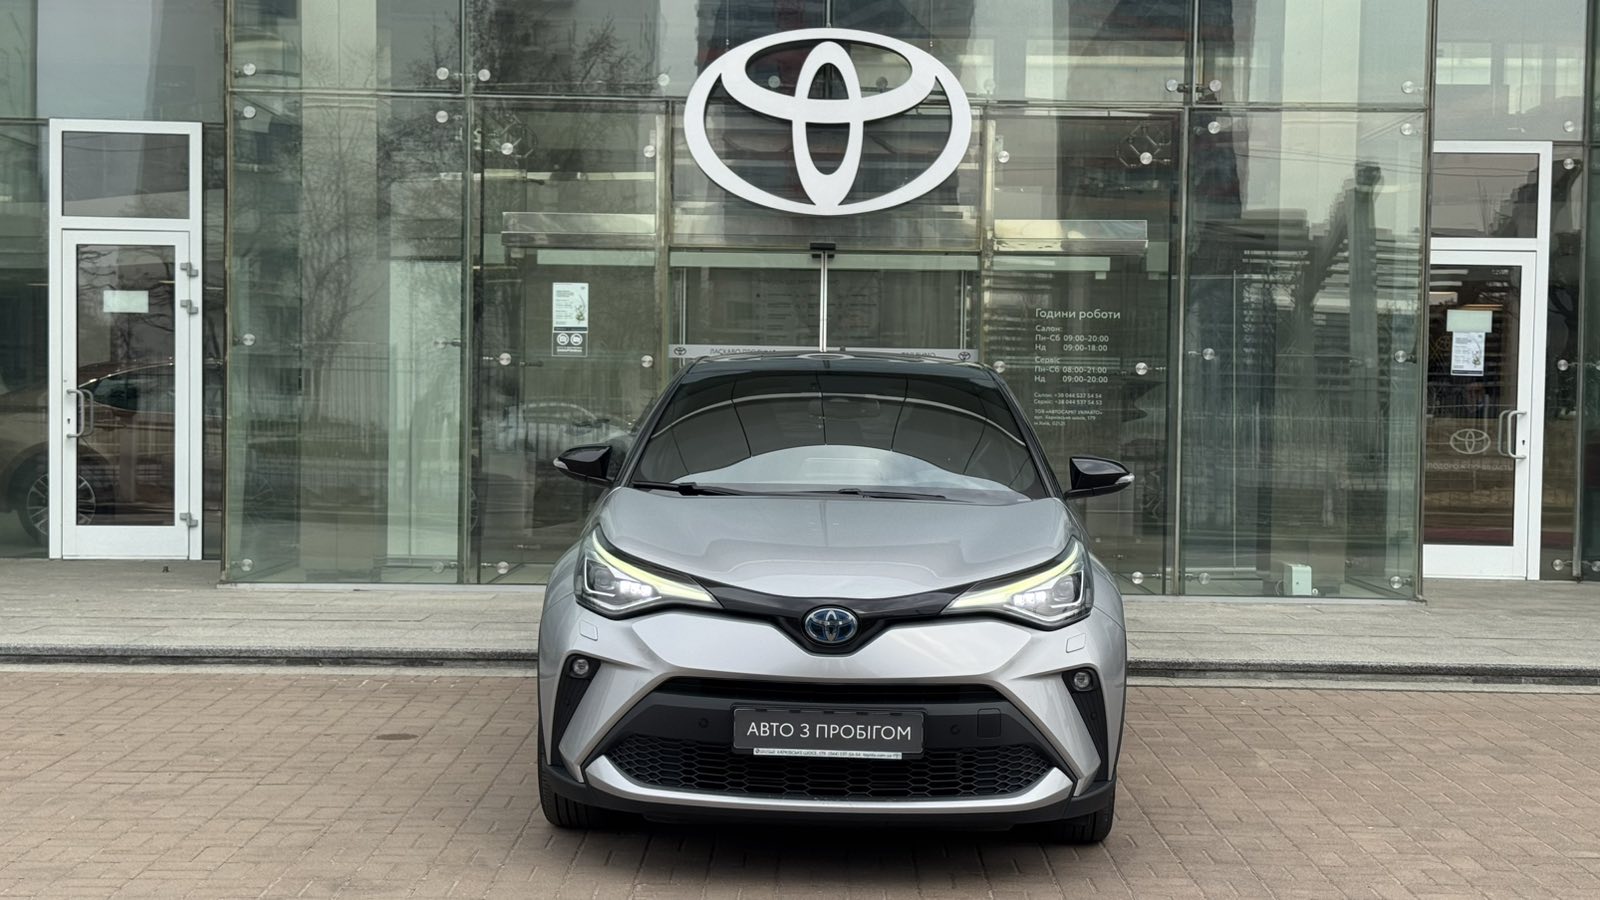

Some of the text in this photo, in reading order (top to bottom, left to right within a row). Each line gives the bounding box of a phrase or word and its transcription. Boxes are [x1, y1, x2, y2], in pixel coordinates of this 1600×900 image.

[1035, 308, 1121, 321] Години роботи
[1035, 324, 1063, 332] Салон:
[1063, 334, 1109, 343] 09:00-20:00
[1034, 343, 1108, 352] Нд 09:00-18:00
[1062, 366, 1108, 374] 08:00-21:00
[1034, 375, 1109, 383] Нд 09:00-20:00
[747, 722, 794, 737] АВТО
[816, 724, 911, 741] ПРОБІГОМ
